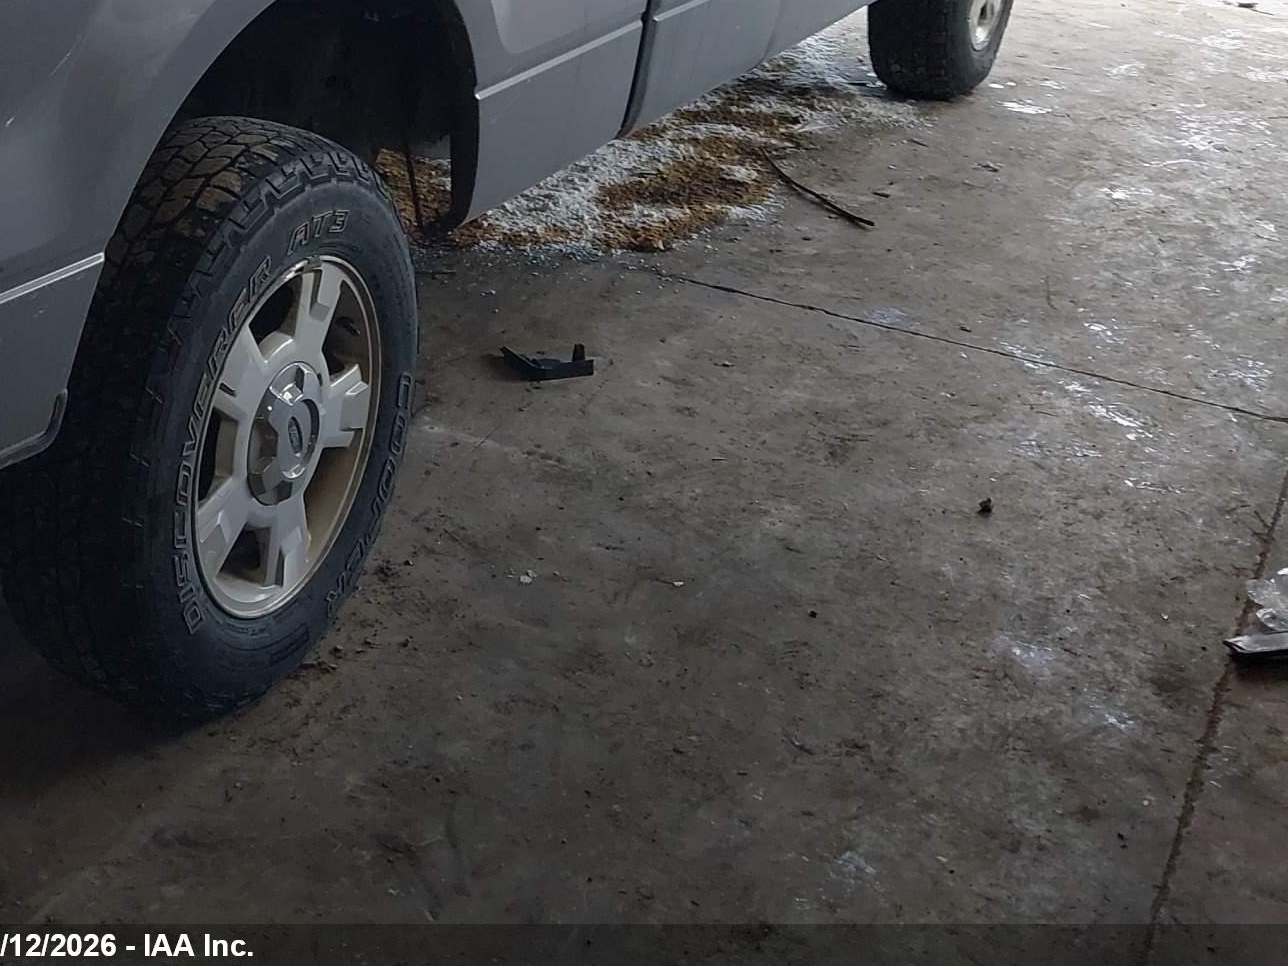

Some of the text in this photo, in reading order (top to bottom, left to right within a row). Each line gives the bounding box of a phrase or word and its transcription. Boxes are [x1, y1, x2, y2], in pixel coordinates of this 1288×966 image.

[173, 255, 272, 635] DISCOVERER
[287, 210, 350, 256] AT3
[325, 371, 414, 619] COOPER
